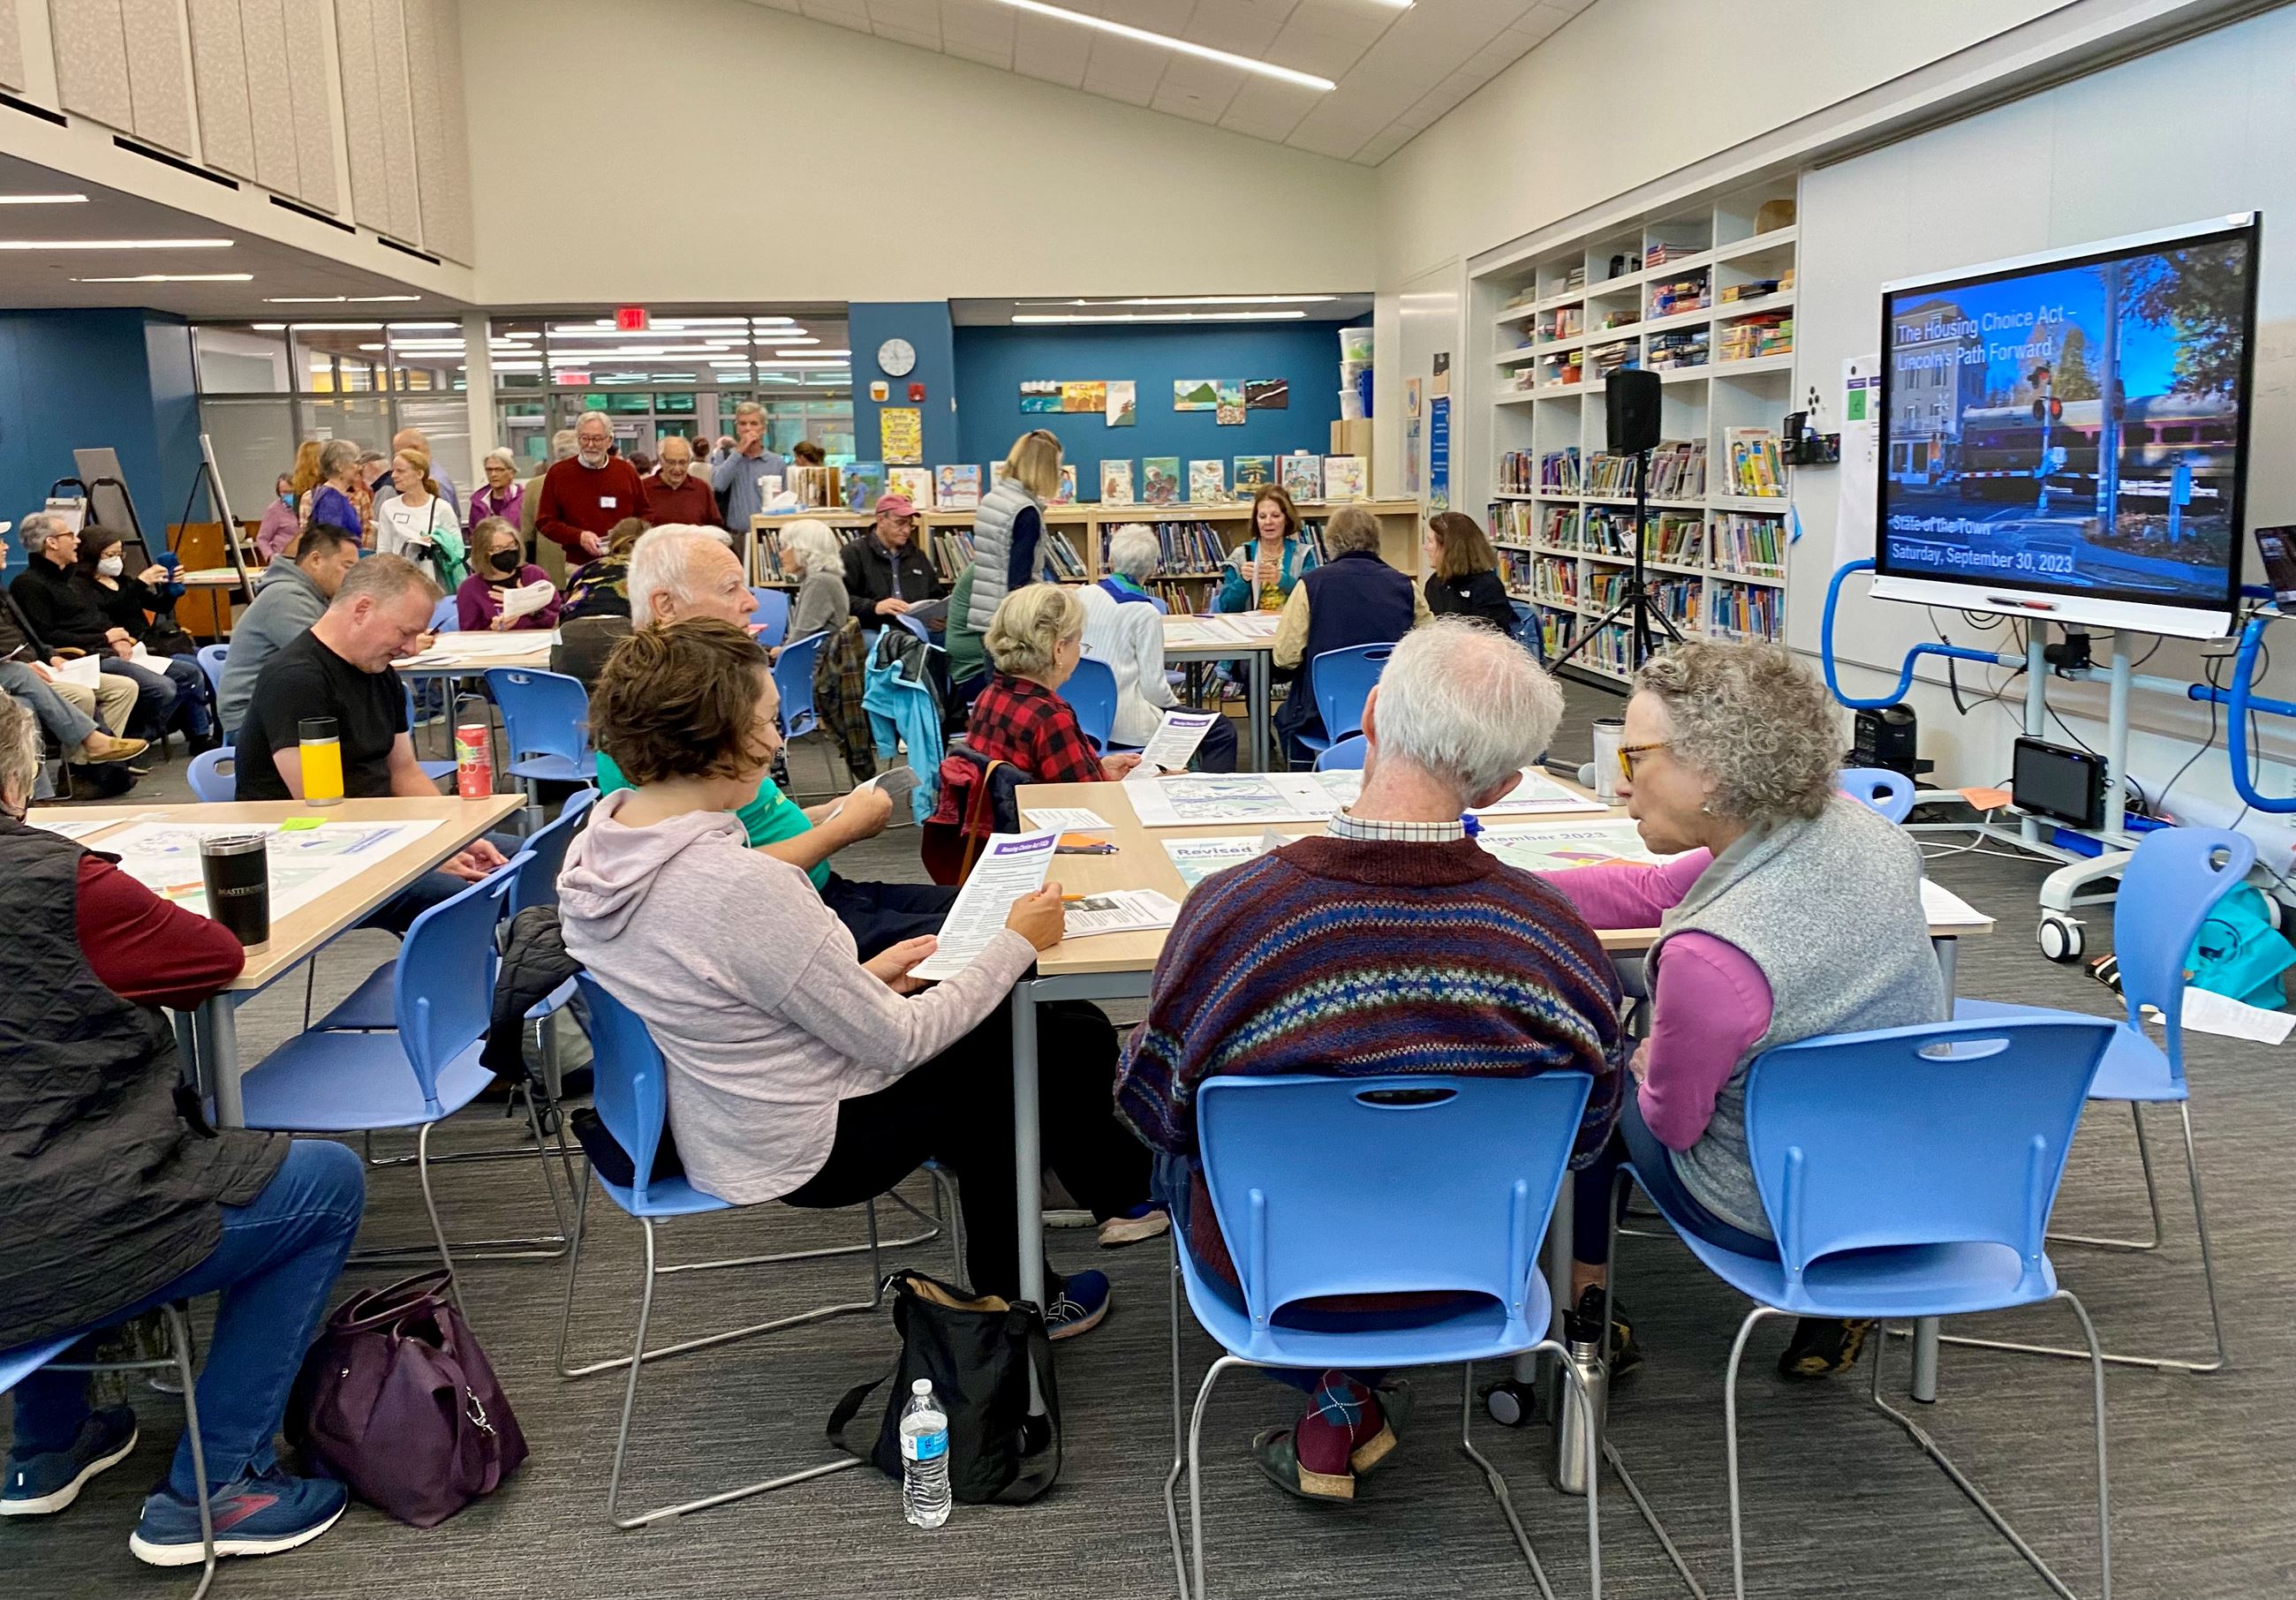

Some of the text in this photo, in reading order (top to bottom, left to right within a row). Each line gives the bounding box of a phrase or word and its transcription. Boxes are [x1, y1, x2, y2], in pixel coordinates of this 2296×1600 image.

[1899, 324, 1922, 343] The
[1924, 317, 1979, 339] Housing
[1982, 310, 2034, 332] Choice
[2035, 305, 2064, 324] Act
[1899, 336, 2052, 371] Lincoln's Path Forward
[1892, 515, 1992, 536] State of the Town
[1892, 543, 2073, 573] Saturday, September 30, 2023
[1560, 831, 1608, 840] 2023
[1177, 846, 1252, 856] Revised
